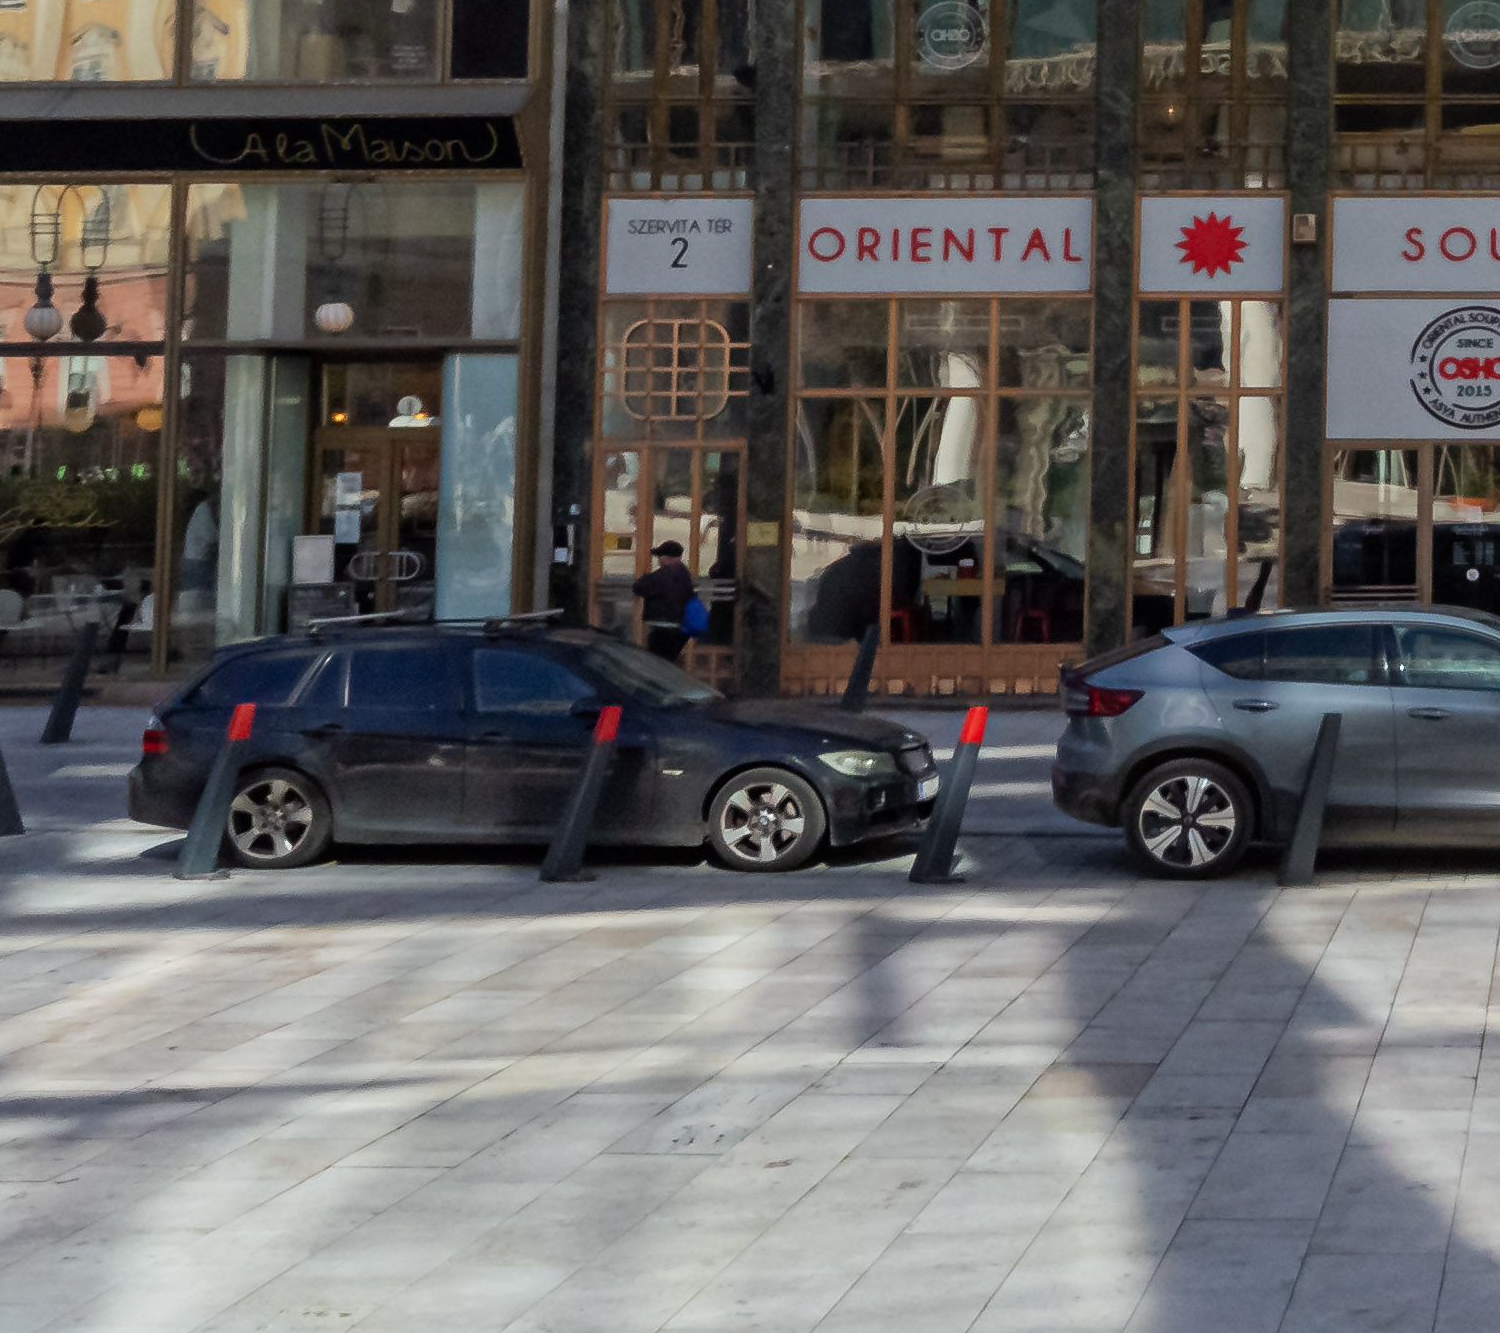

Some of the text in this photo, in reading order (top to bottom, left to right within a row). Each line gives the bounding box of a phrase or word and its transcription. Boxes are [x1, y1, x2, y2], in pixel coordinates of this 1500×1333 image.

[321, 123, 497, 163] Maison
[627, 218, 700, 234] SZERVITA
[670, 236, 689, 269] 2
[807, 225, 1083, 262] ORIENTAL
[1422, 314, 1467, 350] ORIENTAL
[1456, 338, 1494, 349] SINCE
[1456, 385, 1493, 398] 2015
